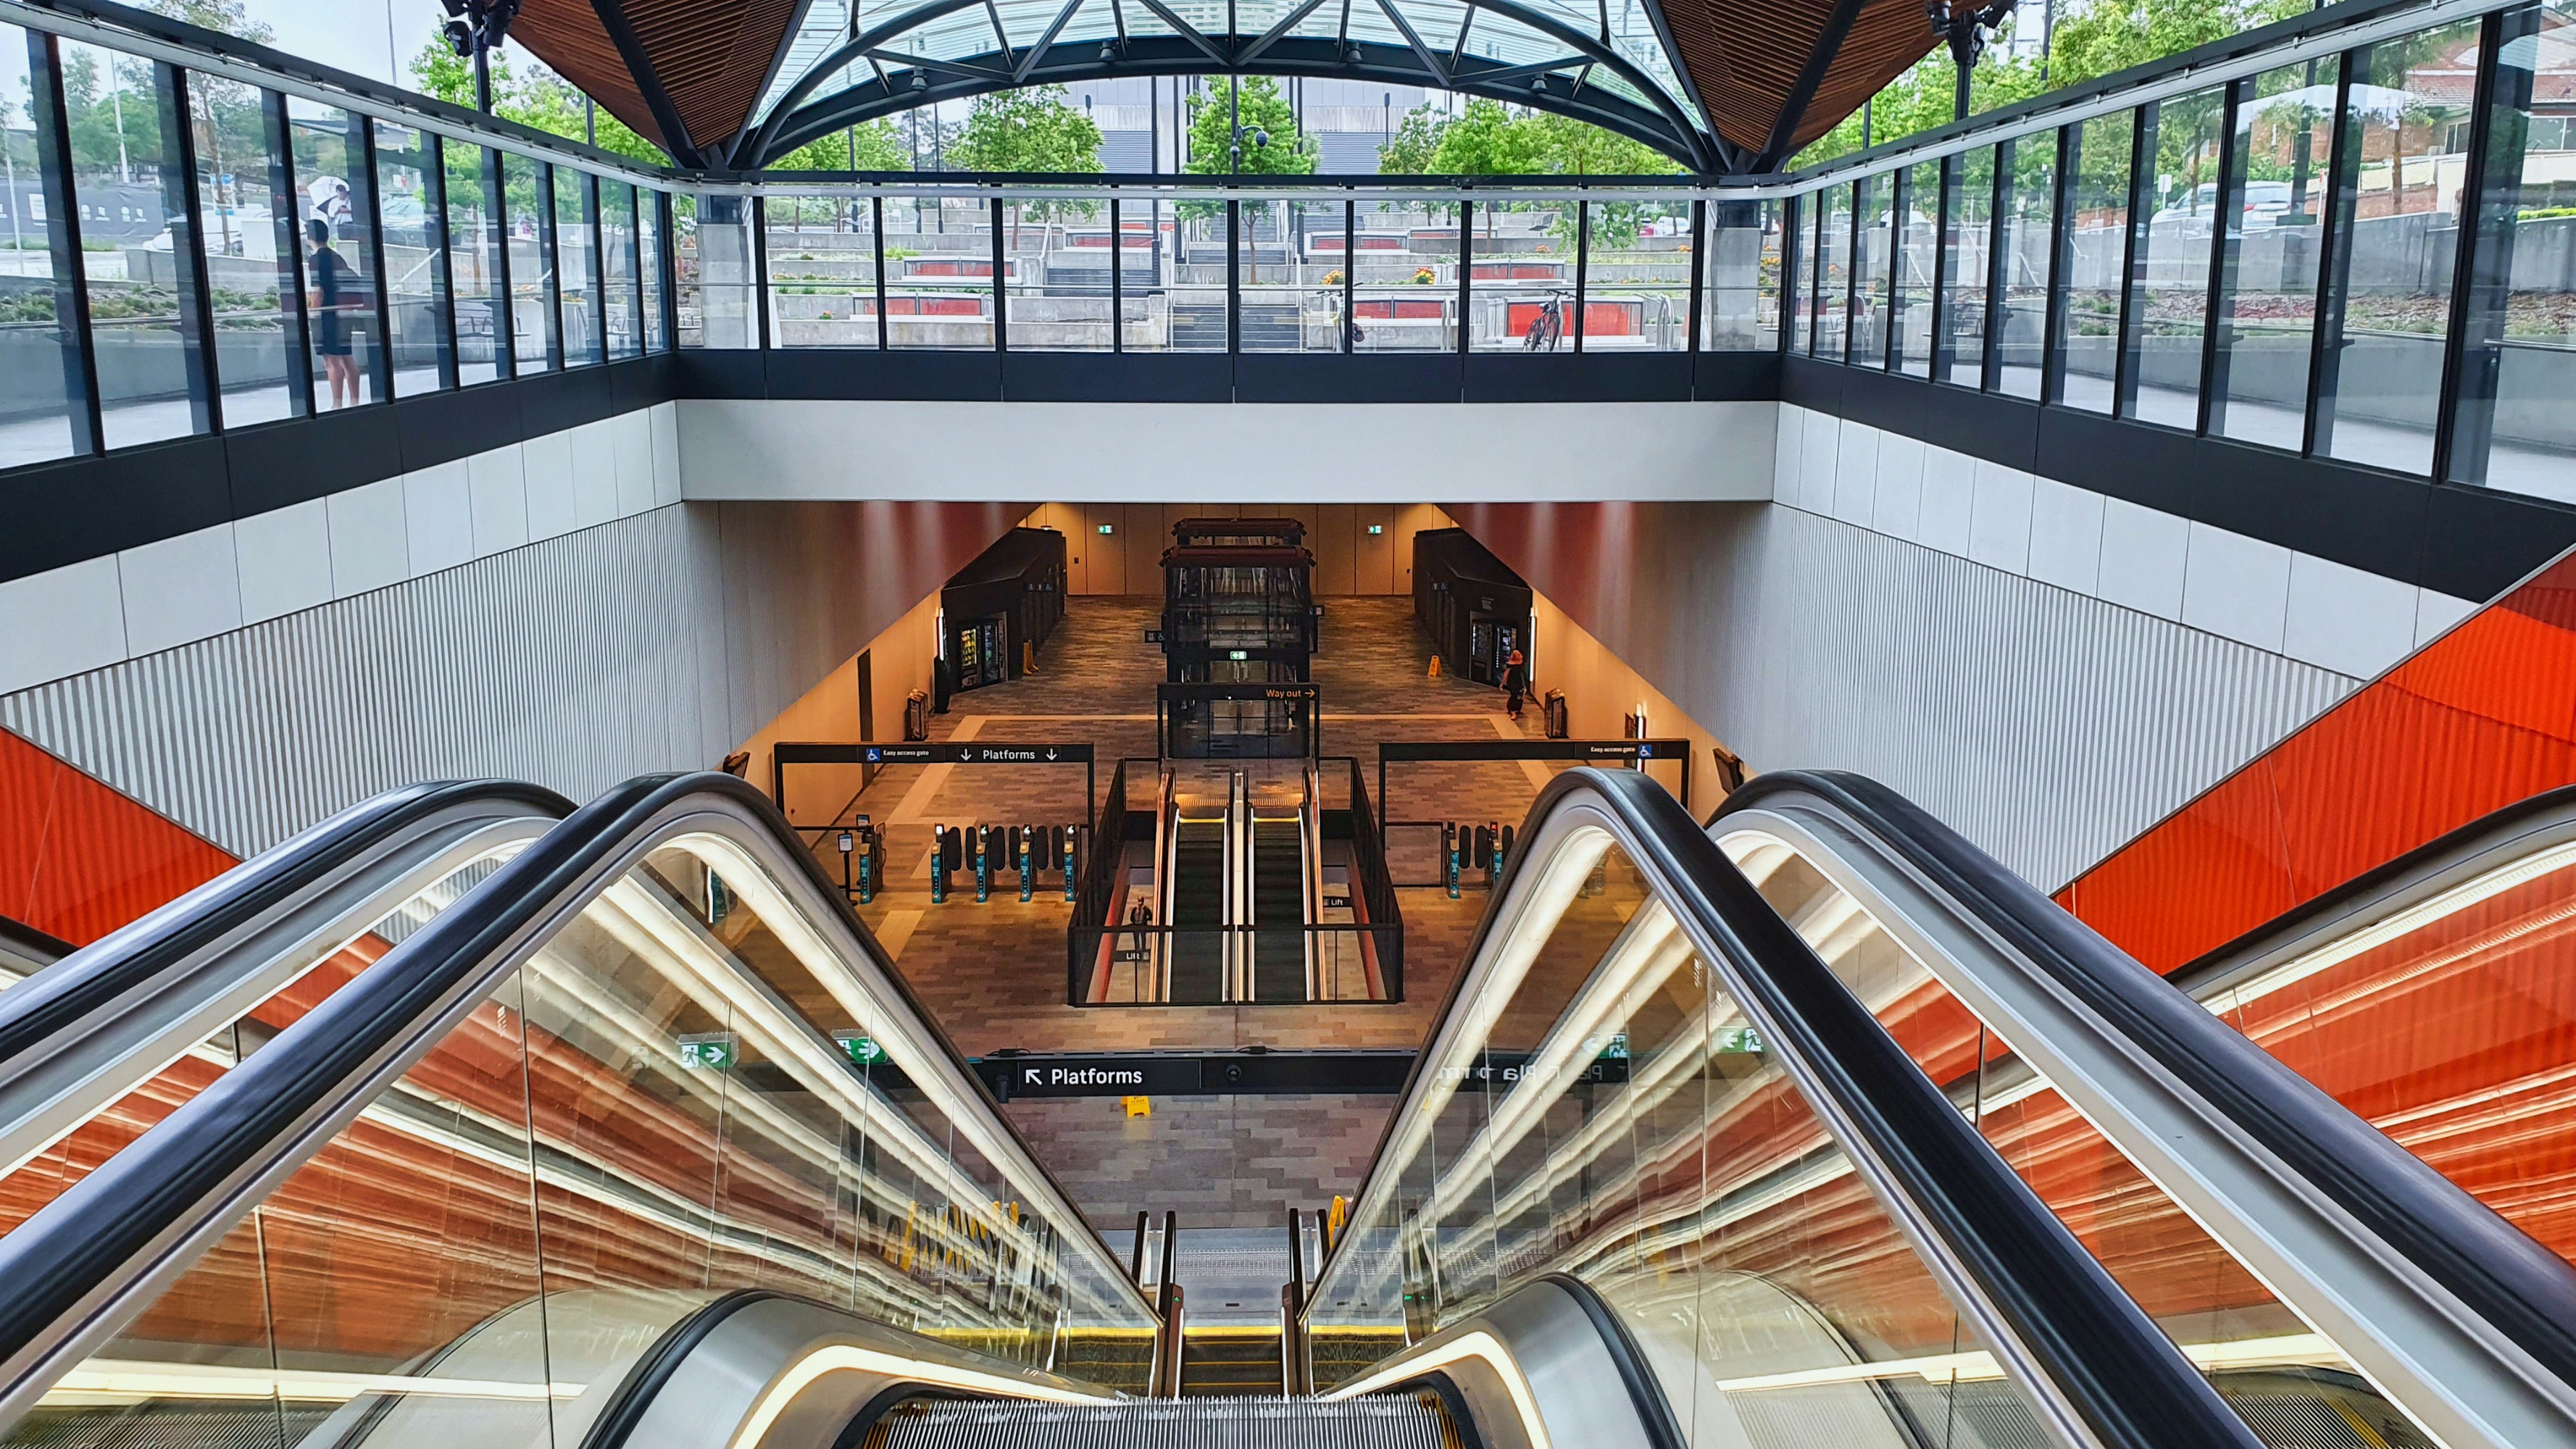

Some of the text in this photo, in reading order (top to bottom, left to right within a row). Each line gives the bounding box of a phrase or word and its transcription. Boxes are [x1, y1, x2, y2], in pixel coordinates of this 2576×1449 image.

[1266, 689, 1285, 699] Way
[983, 750, 1035, 760] Platforms
[1051, 1068, 1143, 1085] Platforms
